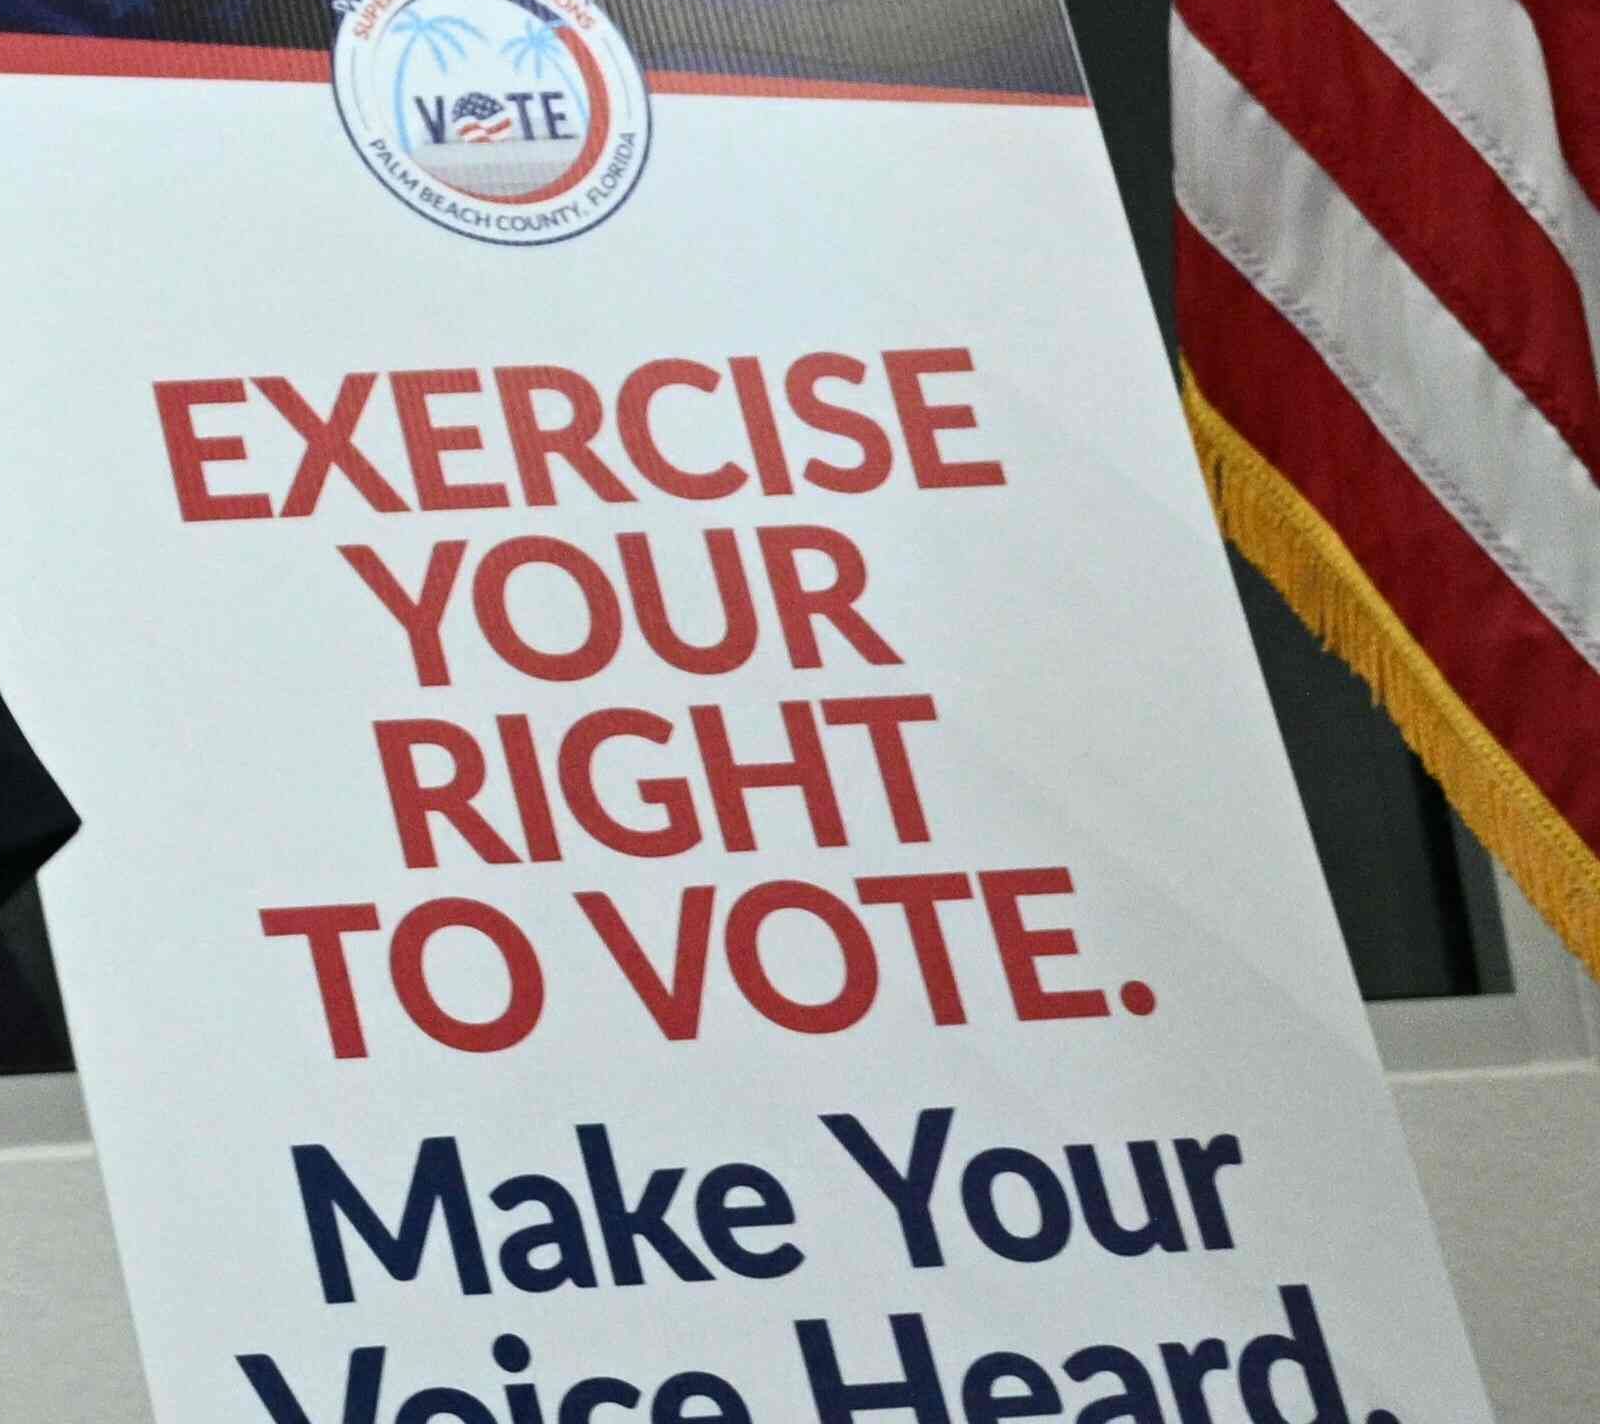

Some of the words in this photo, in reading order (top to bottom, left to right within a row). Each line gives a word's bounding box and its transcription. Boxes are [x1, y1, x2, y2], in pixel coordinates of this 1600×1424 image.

[369, 138, 419, 191] PALM
[420, 188, 490, 229] BEACH
[589, 131, 636, 206] FLORIDA
[414, 91, 576, 144] VOTE
[154, 348, 1006, 522] EXERCISE
[342, 525, 903, 688] YOUR
[373, 695, 937, 870] RIGHT
[260, 898, 546, 1059] TO
[576, 867, 1155, 1041] VOTE.
[291, 1123, 805, 1305] Make
[818, 1107, 1243, 1269] Your
